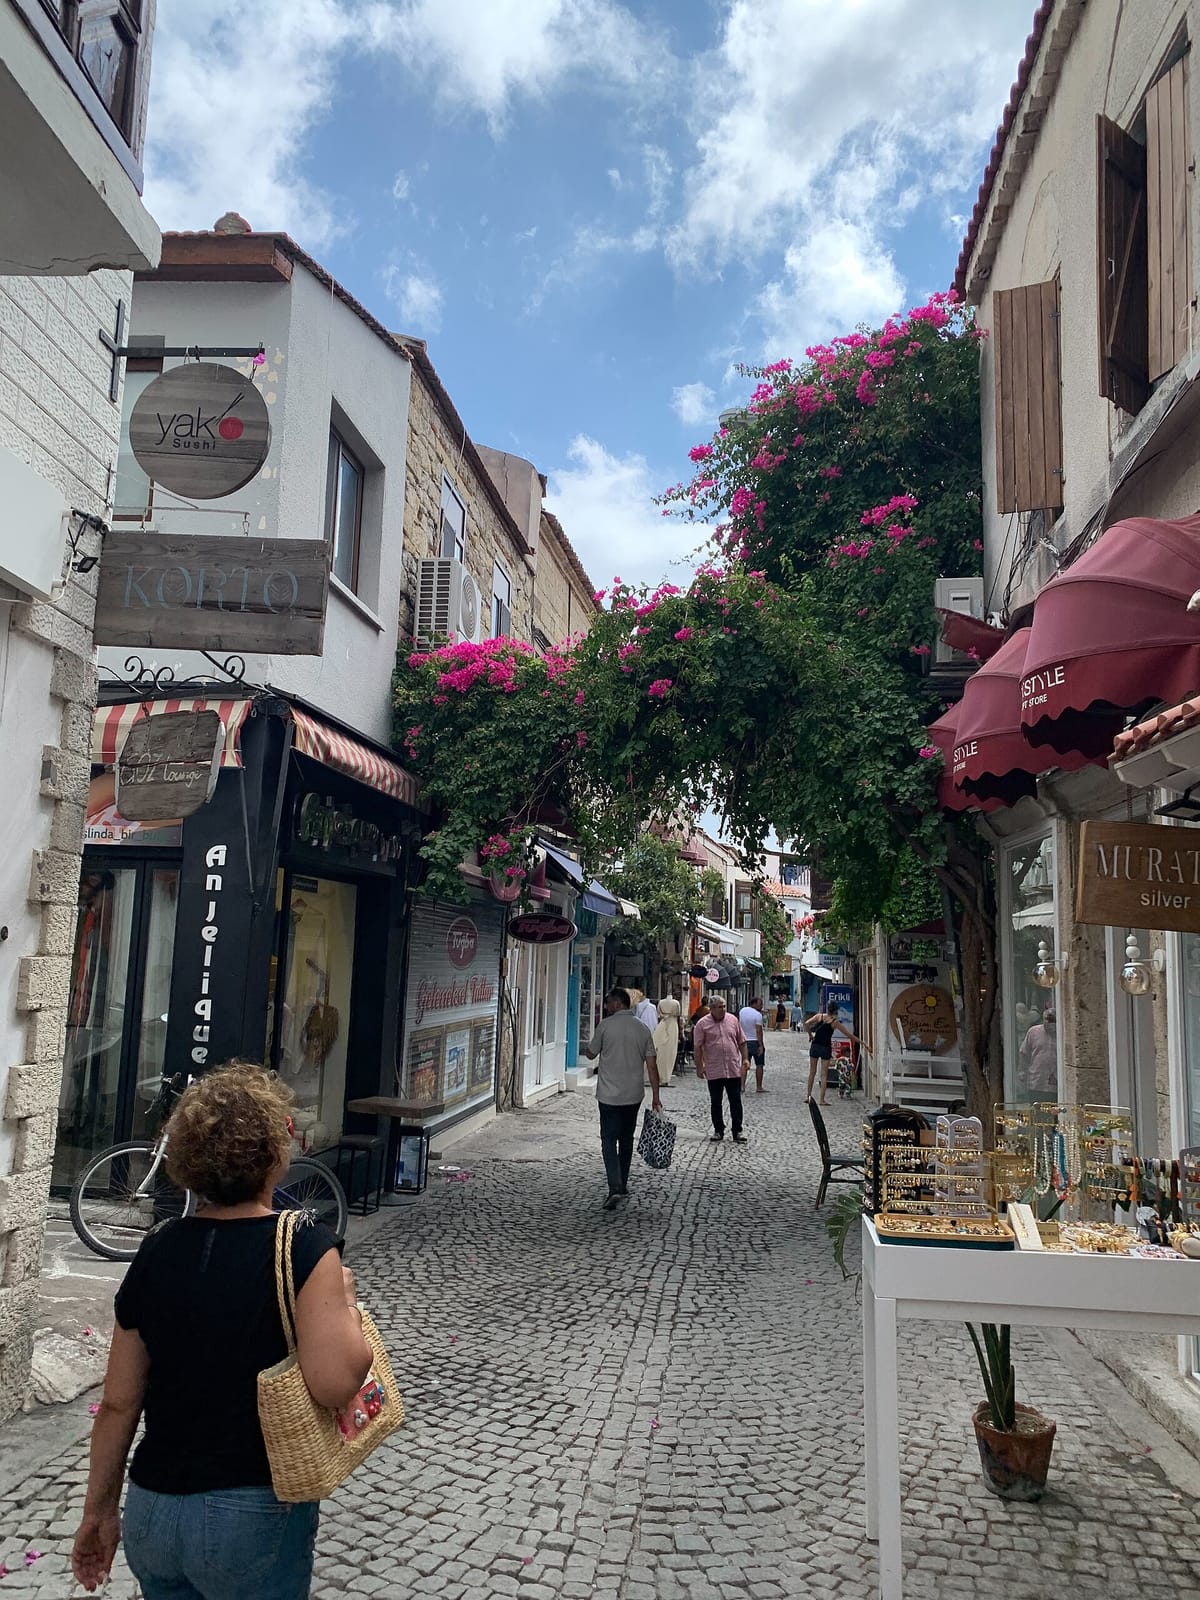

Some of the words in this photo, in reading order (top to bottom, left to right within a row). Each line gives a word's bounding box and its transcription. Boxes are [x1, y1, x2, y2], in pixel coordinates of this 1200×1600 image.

[172, 437, 217, 451] Sushi
[123, 563, 300, 614] KORTO
[1029, 693, 1048, 708] STORE
[1140, 891, 1191, 910] silver
[828, 992, 851, 1001] Erikli
